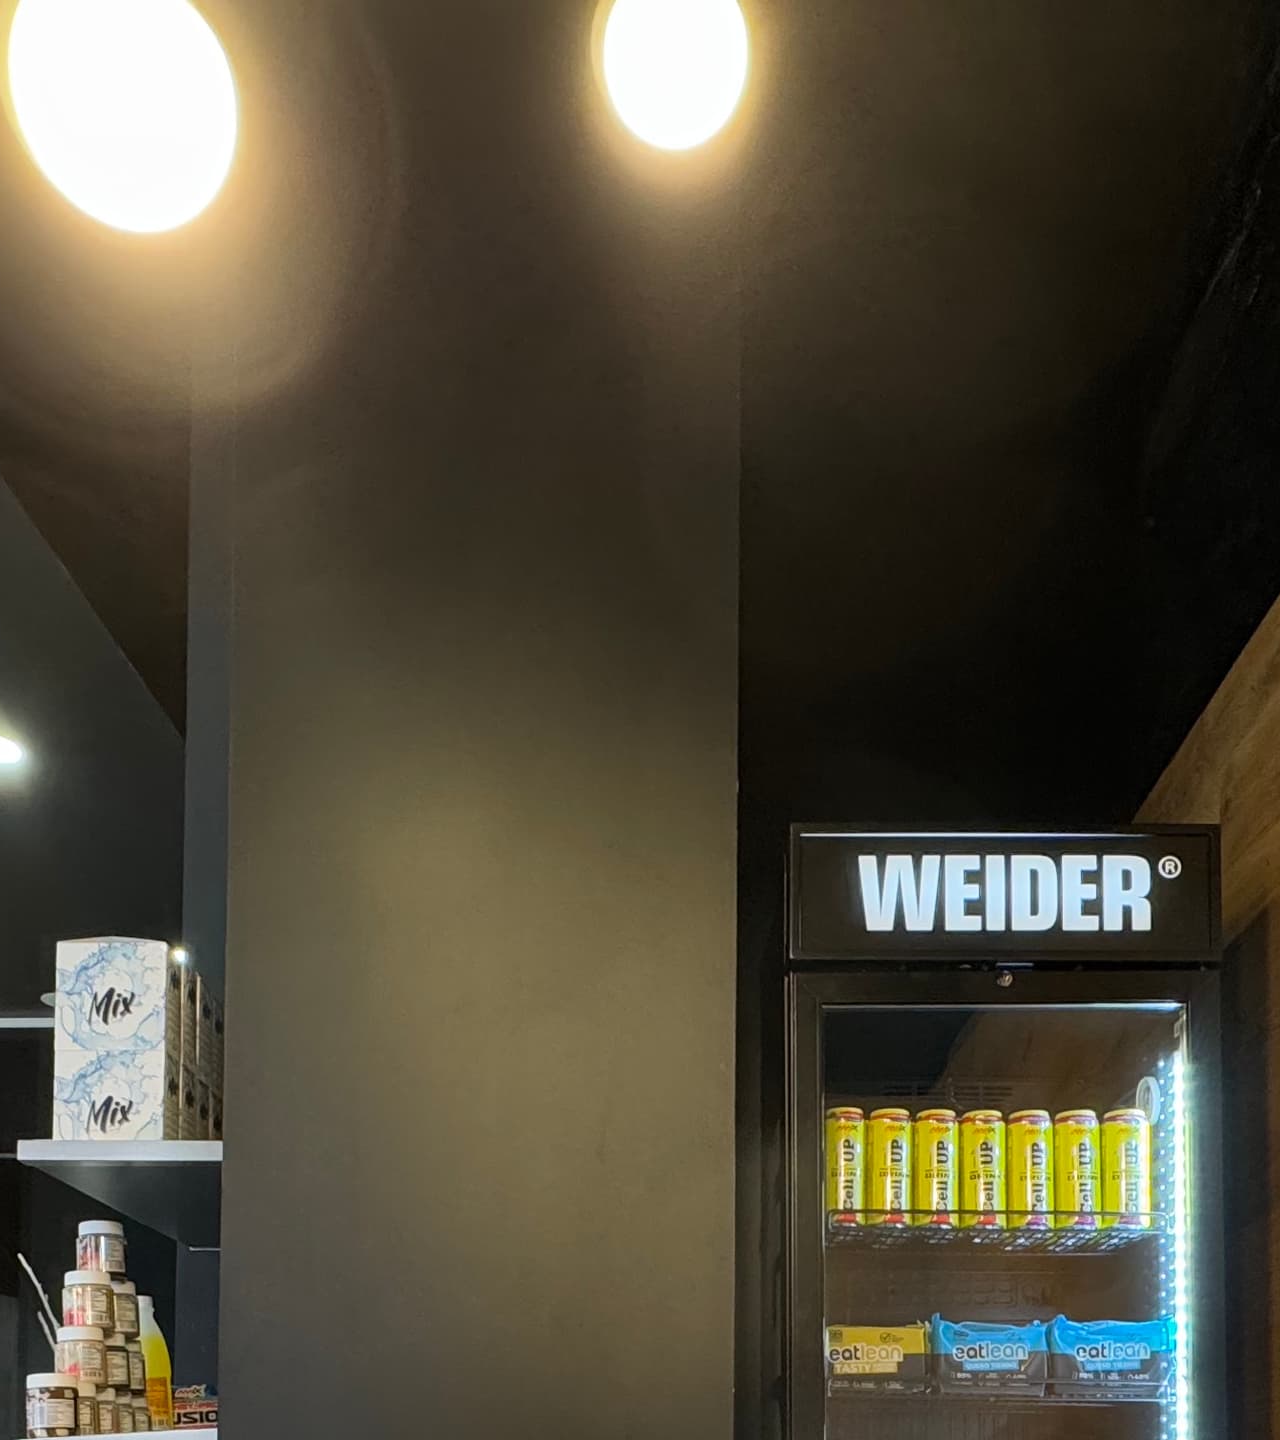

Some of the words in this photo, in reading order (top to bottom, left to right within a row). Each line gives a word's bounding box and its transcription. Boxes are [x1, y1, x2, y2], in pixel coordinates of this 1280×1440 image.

[858, 854, 1152, 931] WEIDER
[87, 986, 136, 1026] Mix
[85, 1095, 134, 1135] Mix
[829, 1343, 903, 1362] eatlean
[954, 1343, 1029, 1361] eatlean
[1075, 1342, 1150, 1360] eatlean
